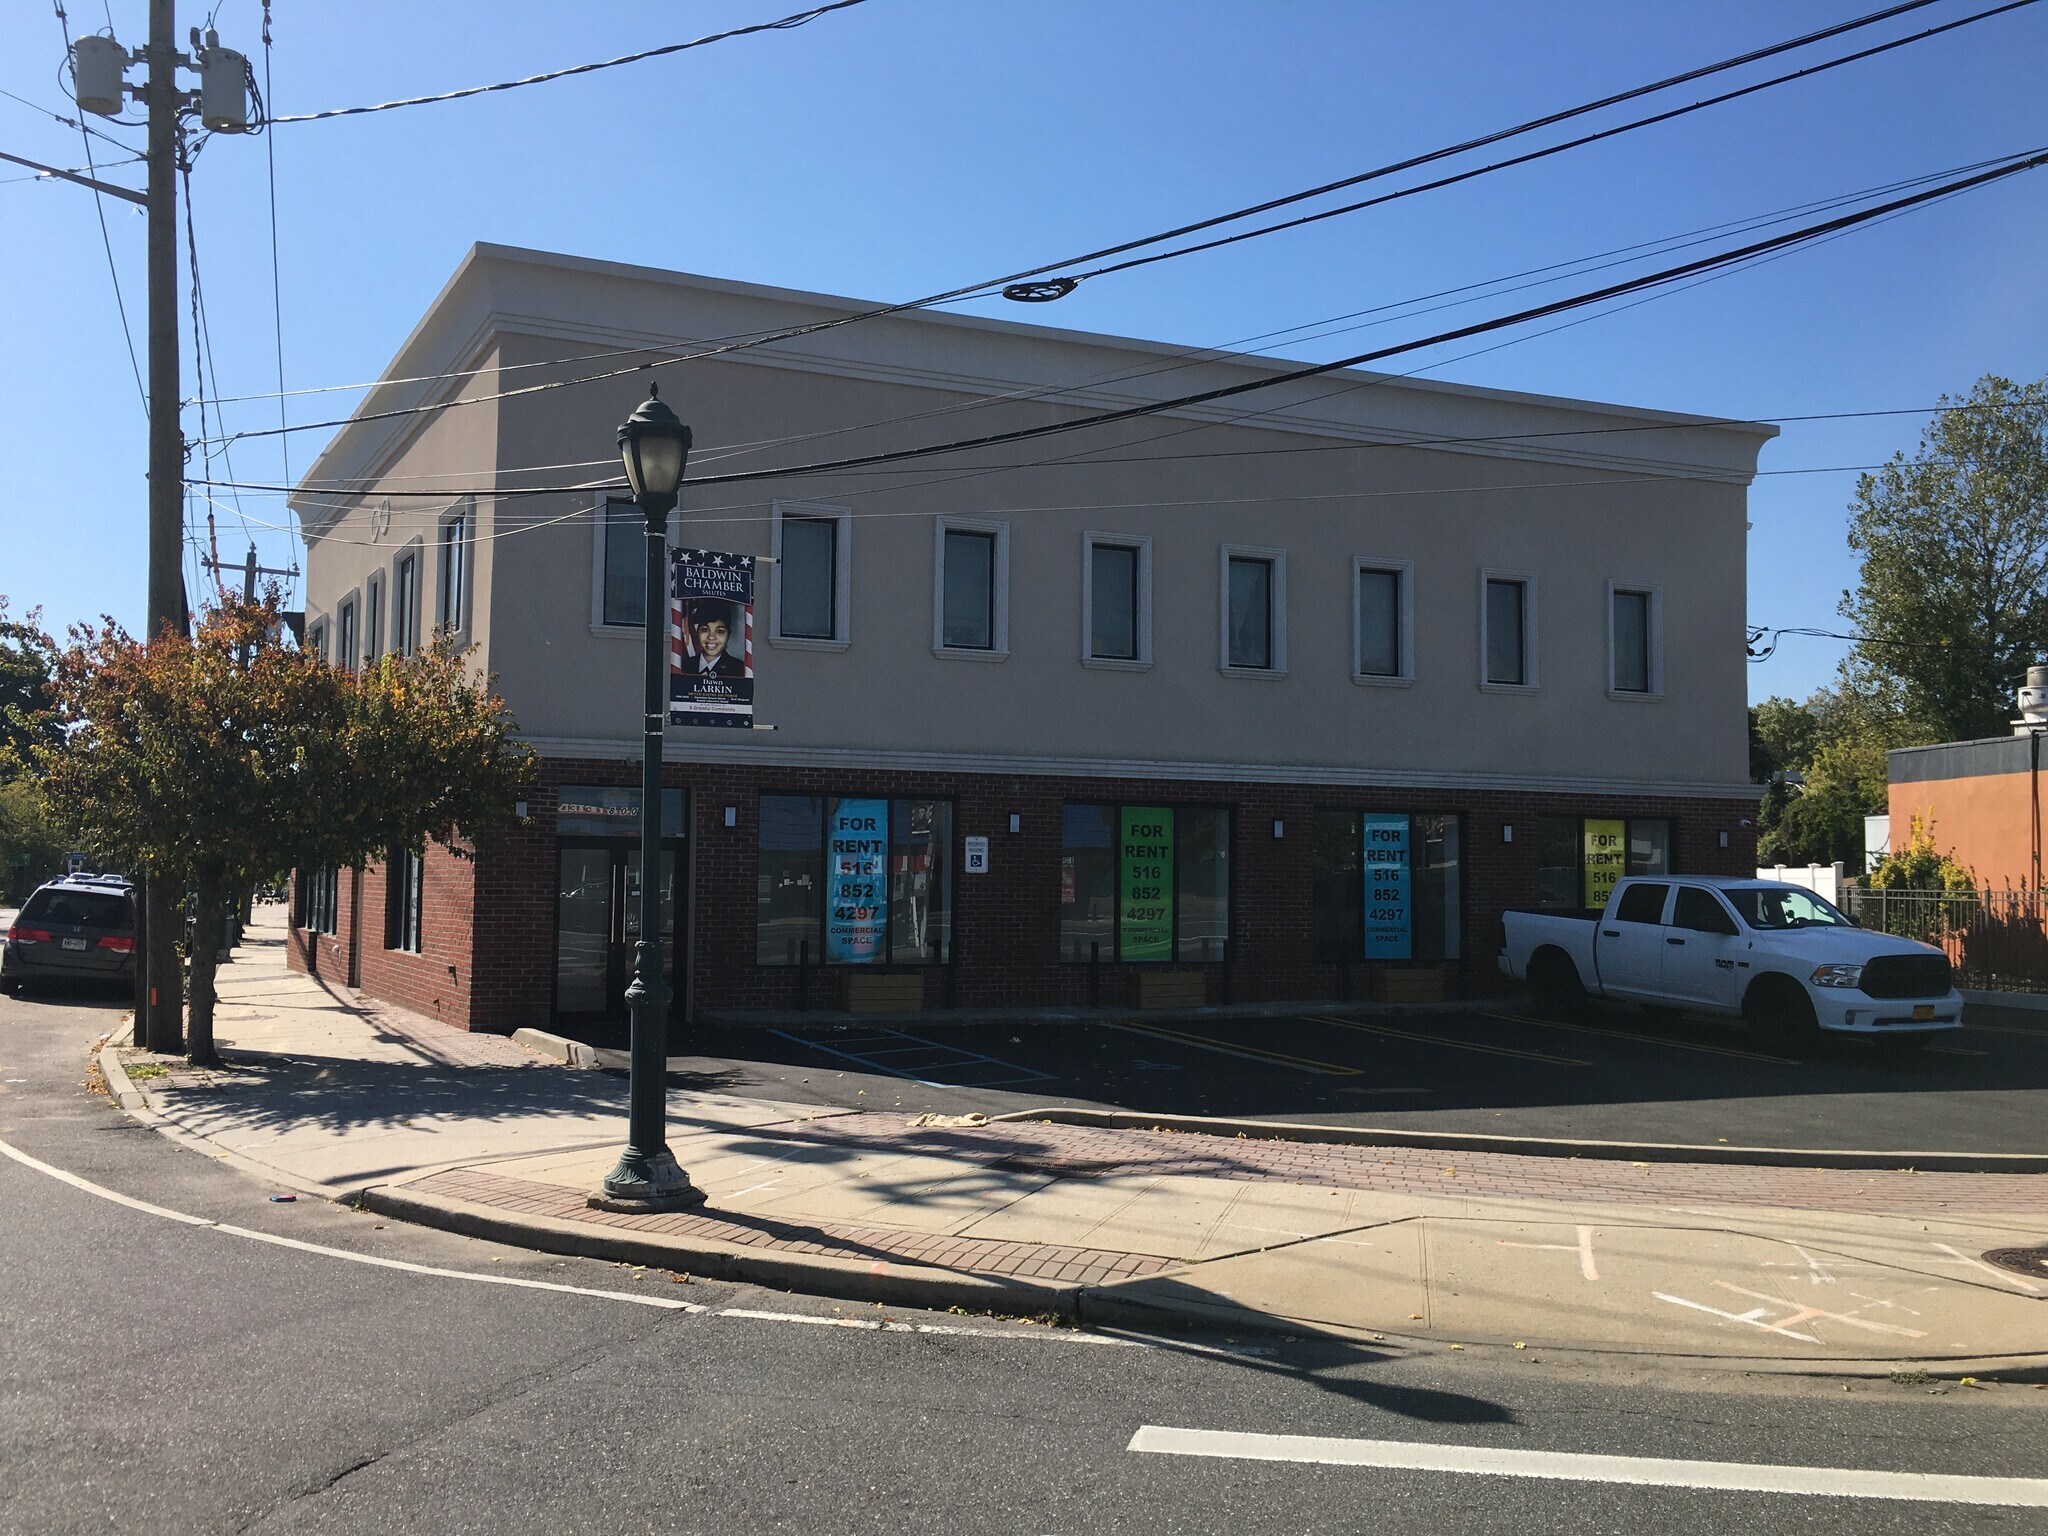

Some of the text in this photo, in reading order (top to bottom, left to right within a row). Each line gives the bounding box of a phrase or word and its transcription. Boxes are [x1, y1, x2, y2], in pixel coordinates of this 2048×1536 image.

[686, 567, 742, 581] BALDWIN
[684, 577, 744, 592] CHAMBER
[693, 684, 733, 694] LARKIN
[839, 817, 876, 831] FOR
[1130, 824, 1163, 837] FOR
[1372, 830, 1400, 842] FOR
[1591, 835, 1617, 846] FOR
[832, 840, 882, 853] RENT
[1125, 845, 1168, 858] RENT
[1367, 850, 1405, 861] RENT
[1586, 853, 1622, 865] RENT
[841, 861, 874, 876] 516
[1132, 866, 1161, 879] 516
[1373, 869, 1399, 881] 516
[1593, 872, 1616, 883] 516
[841, 884, 873, 898] 852
[1132, 887, 1160, 900] 852
[1373, 889, 1400, 901] 852
[1593, 890, 1612, 902] 85
[835, 906, 879, 920] 4297
[1127, 908, 1165, 921] 4297
[1369, 908, 1404, 920] 4297
